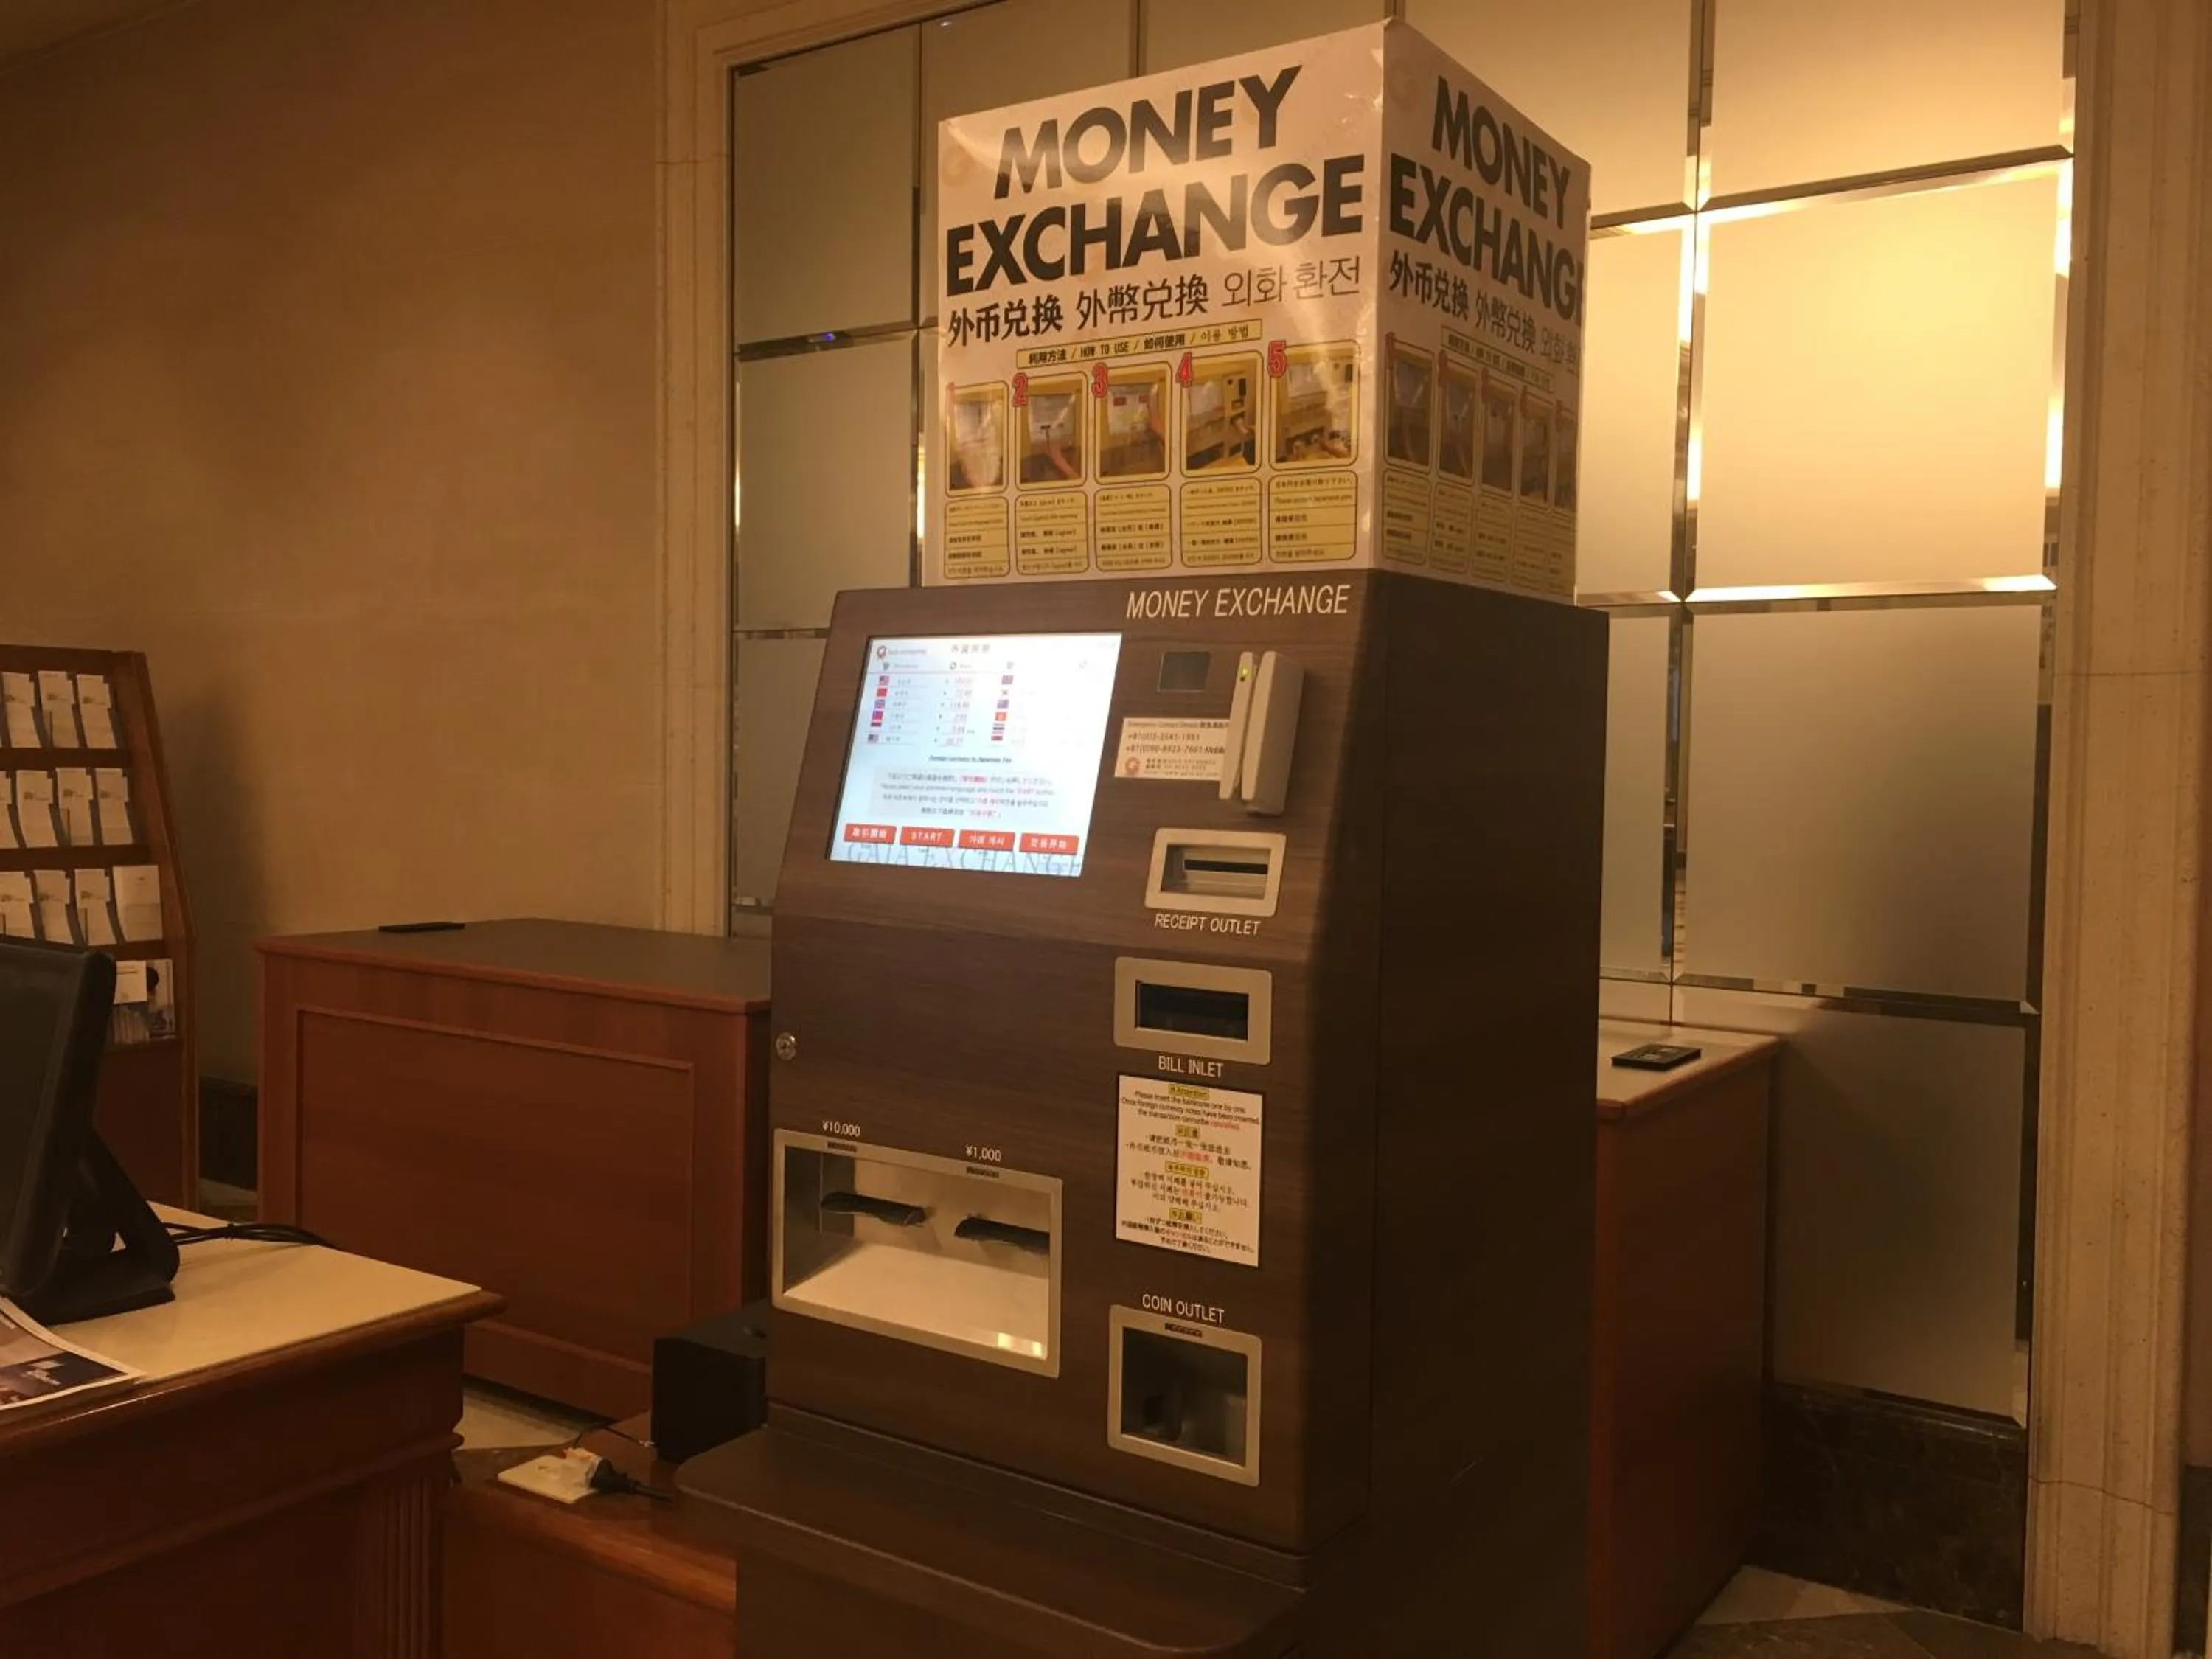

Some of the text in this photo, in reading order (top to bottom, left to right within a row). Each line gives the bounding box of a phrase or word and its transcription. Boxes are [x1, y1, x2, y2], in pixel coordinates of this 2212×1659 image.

[994, 65, 1302, 199] MONEY
[1432, 75, 1571, 229] MONEY
[946, 153, 1365, 296] EXCHANGE
[1222, 255, 1360, 307] 외화 환전
[1080, 345, 1096, 358] HOW
[1100, 344, 1110, 355] TO
[1114, 341, 1130, 354] USE
[1144, 333, 1185, 350] 如何使用
[1175, 352, 1193, 388] 4
[1267, 340, 1288, 378] 5
[1013, 372, 1029, 407] 2
[1092, 362, 1108, 398] 3
[1126, 585, 1351, 619] MONEY EXCHANGE
[911, 831, 942, 842] START
[1155, 913, 1262, 936] RECEIPT OUTLET
[1158, 1055, 1224, 1078] BILL INLET
[822, 1120, 860, 1137] ¥10,000
[966, 1144, 1002, 1162] ¥1,000
[1142, 1294, 1225, 1324] COIN OUTLET
